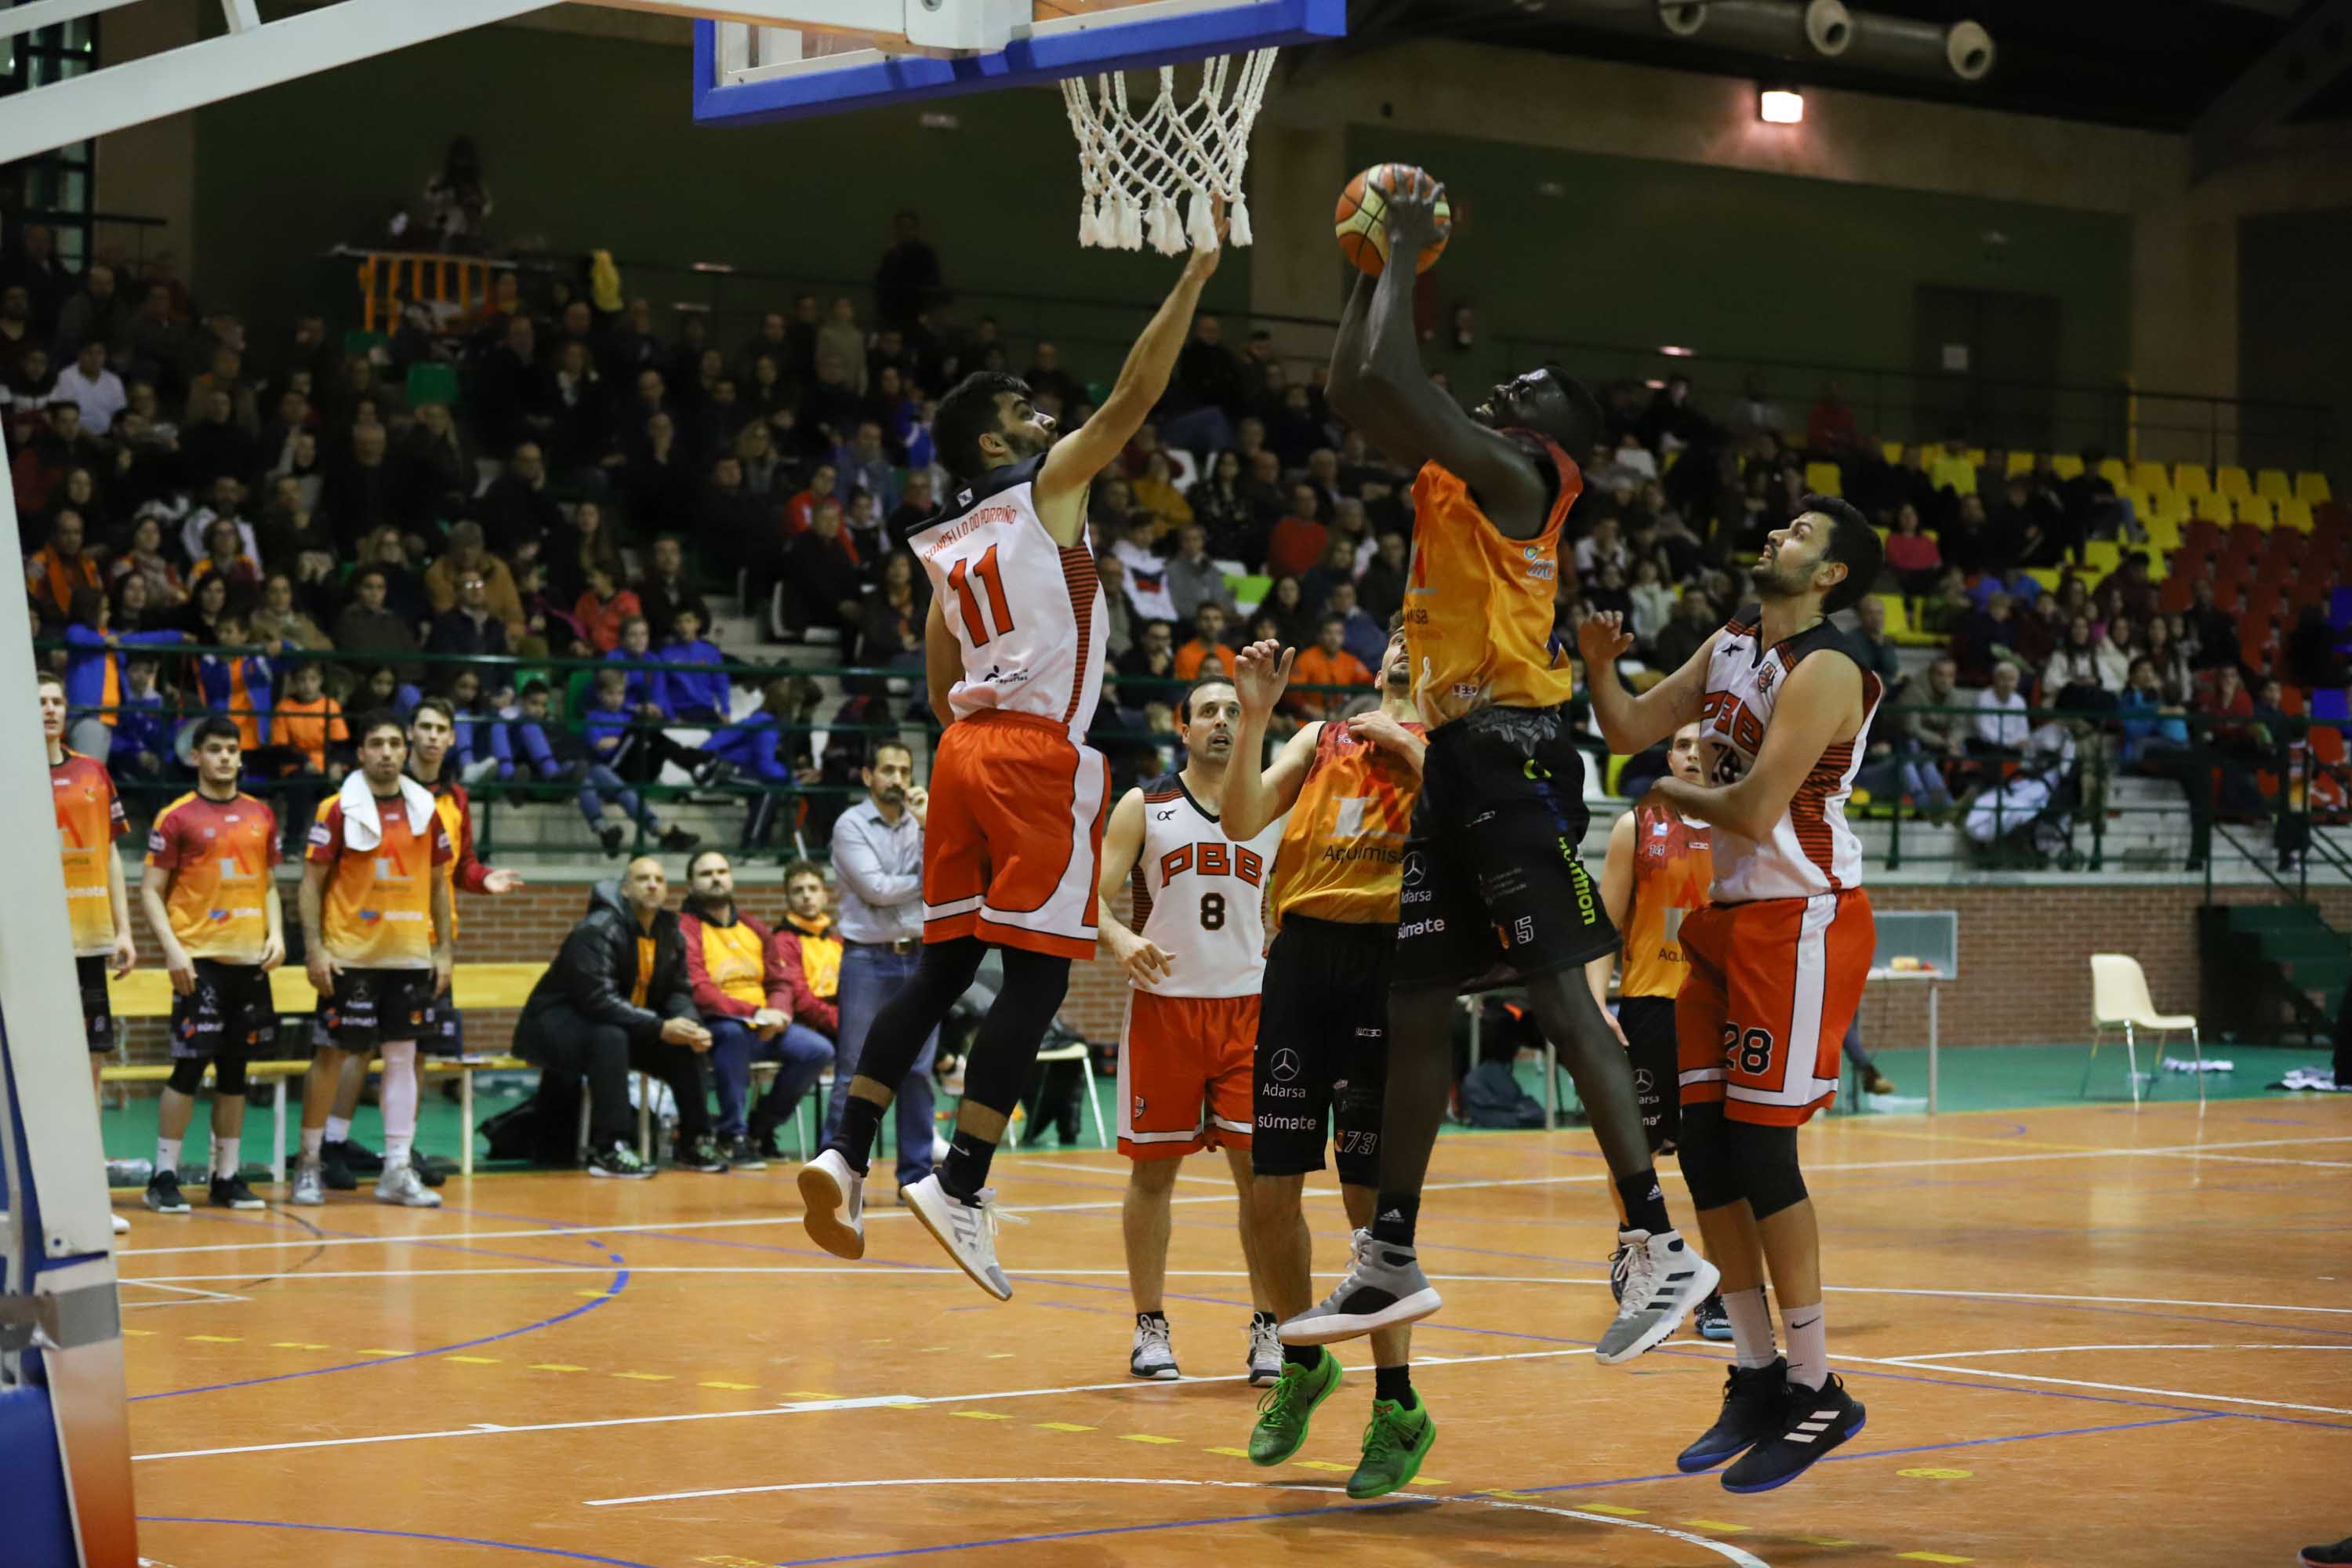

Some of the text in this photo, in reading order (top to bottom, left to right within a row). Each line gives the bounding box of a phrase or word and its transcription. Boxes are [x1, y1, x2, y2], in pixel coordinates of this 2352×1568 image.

[924, 505, 1017, 561] CONCELLO DO PORRIÑO
[947, 543, 1014, 648] 11
[1160, 842, 1263, 888] PBB
[1200, 892, 1225, 931] 8
[1515, 916, 1534, 945] 5
[1725, 1022, 1773, 1076] 28
[1262, 1083, 1305, 1098] Adarsa
[1258, 1113, 1317, 1130] súmate
